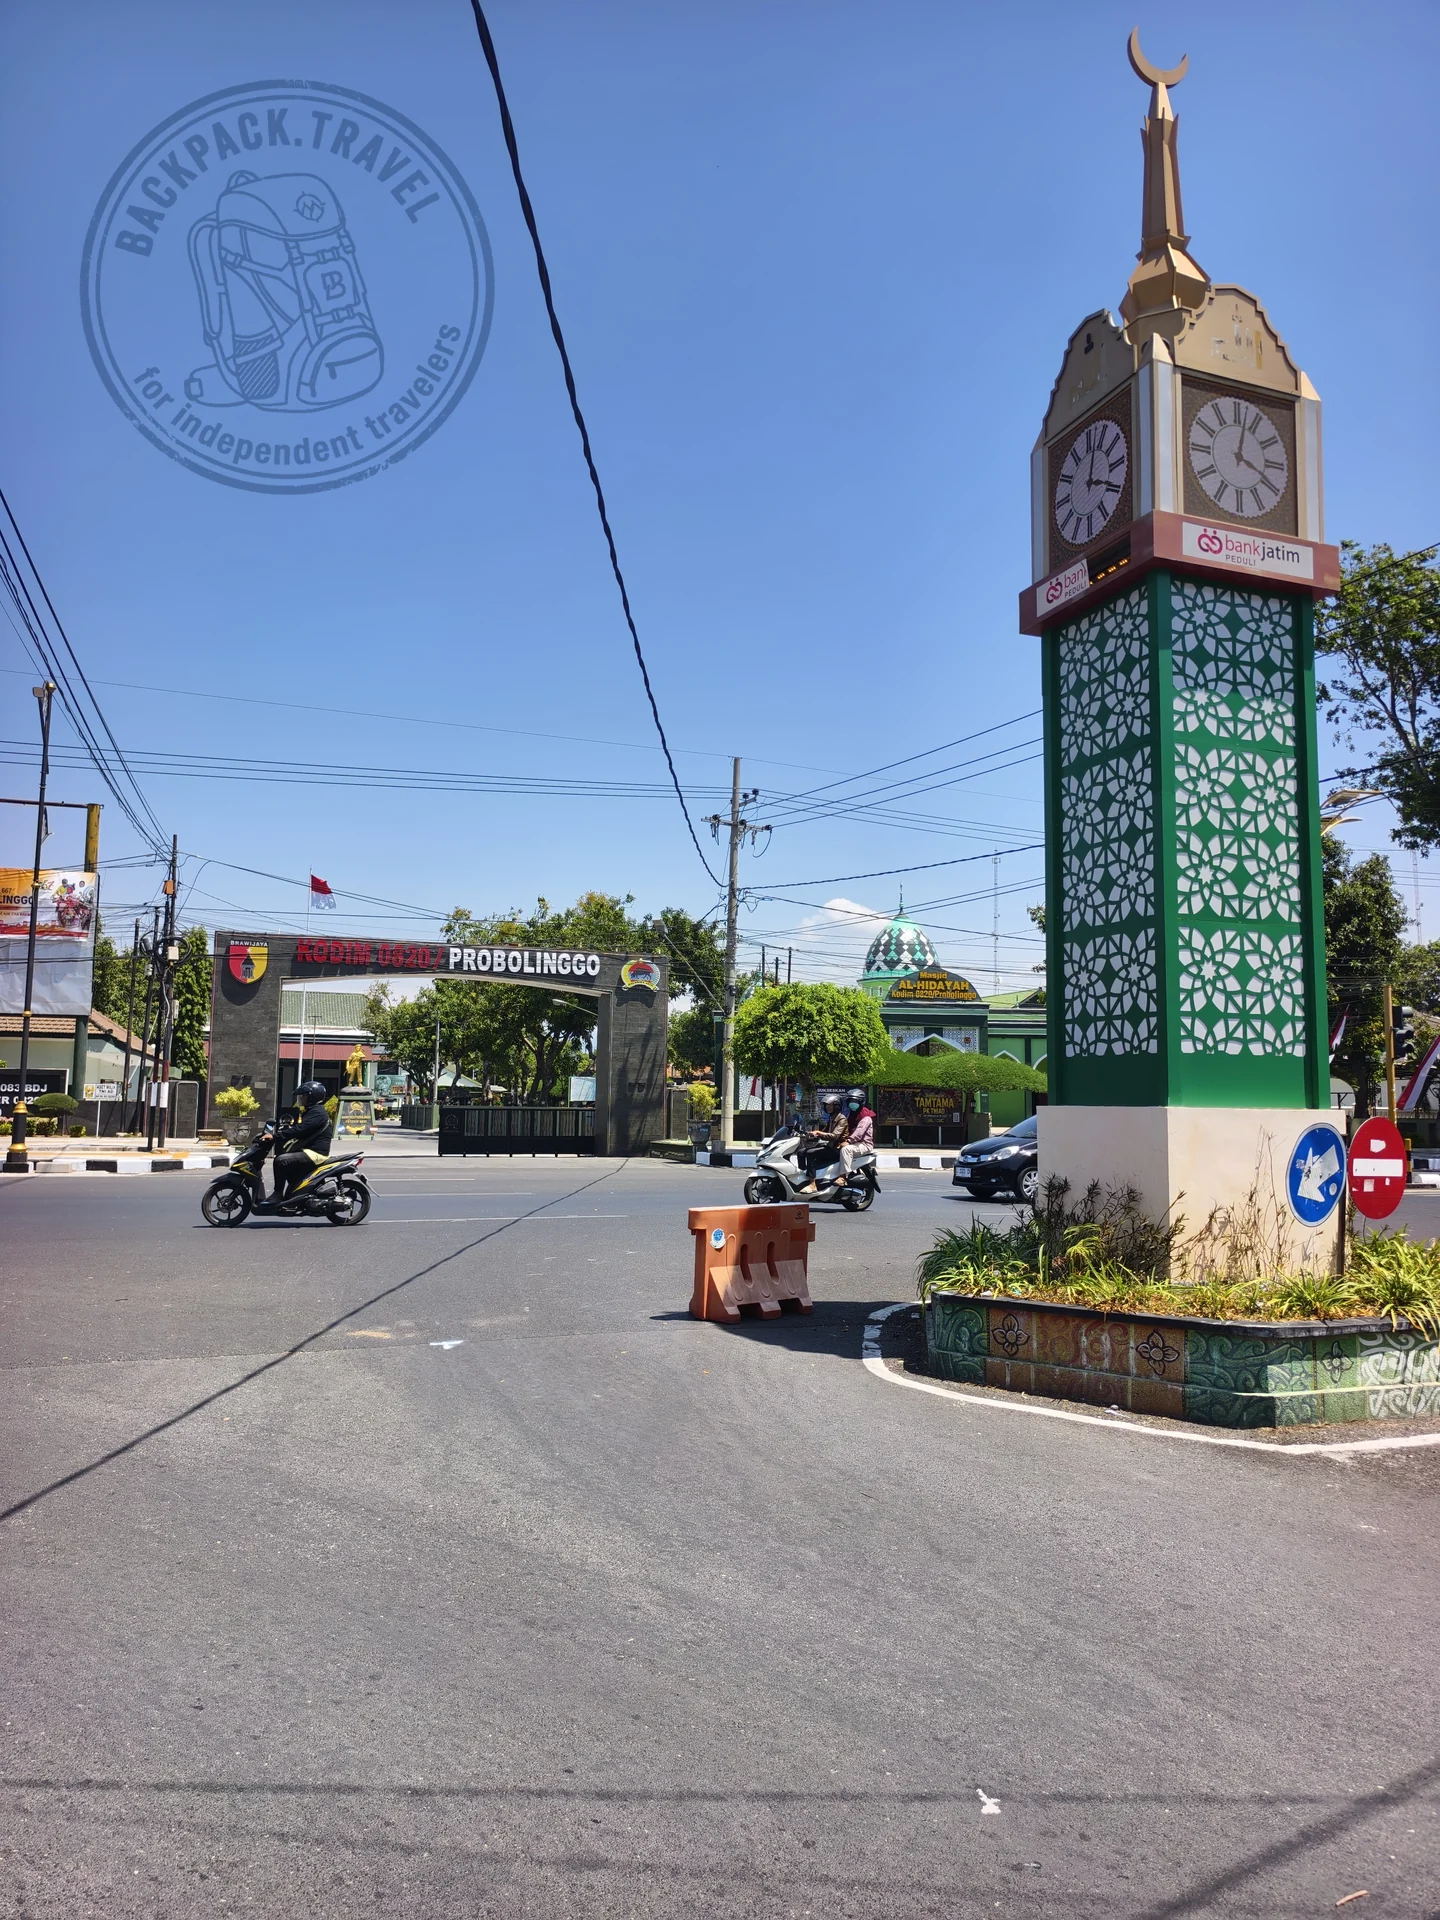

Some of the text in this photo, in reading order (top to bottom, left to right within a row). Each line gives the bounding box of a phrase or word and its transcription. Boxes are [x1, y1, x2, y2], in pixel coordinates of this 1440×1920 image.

[1225, 554, 1256, 566] PEDULI
[1065, 581, 1087, 599] PEDULI
[297, 938, 370, 966] KODIM
[449, 947, 600, 977] PROBOLINGGO
[920, 971, 947, 980] Masjid
[898, 980, 969, 990] AL-HIDAYAH
[891, 990, 914, 998] Kodim
[914, 1097, 955, 1109] TAMTAMA
